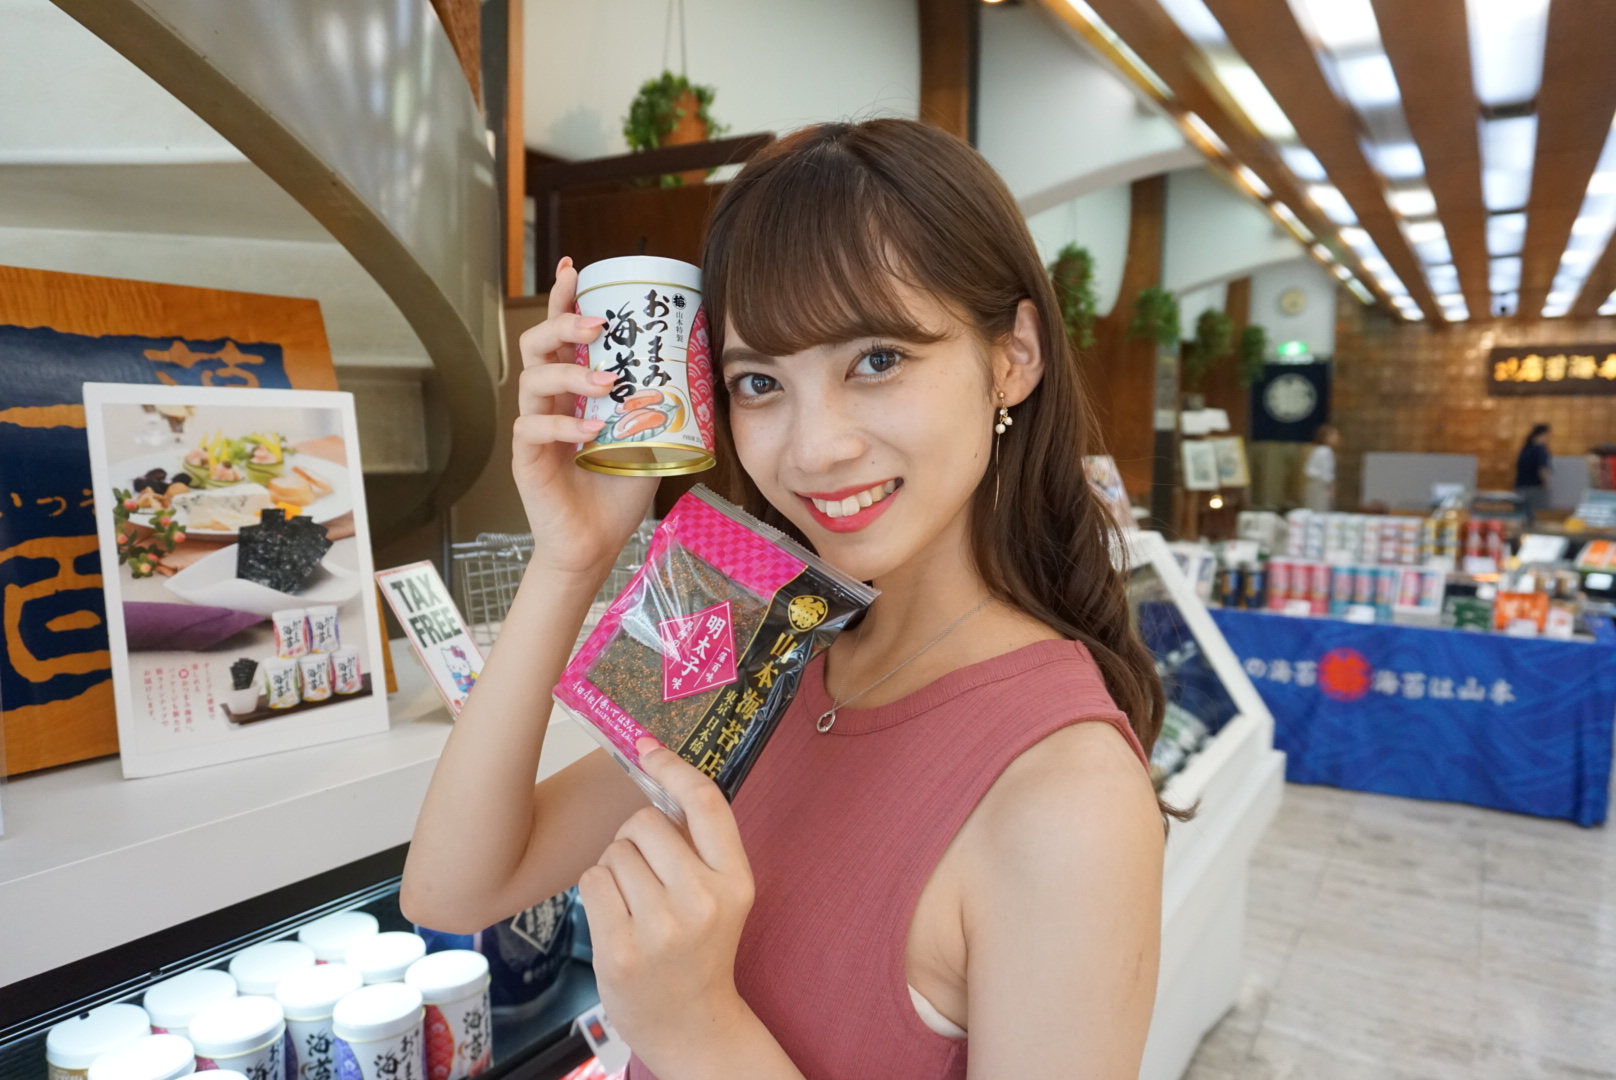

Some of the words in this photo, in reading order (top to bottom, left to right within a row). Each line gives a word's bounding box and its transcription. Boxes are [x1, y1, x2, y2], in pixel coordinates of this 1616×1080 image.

[601, 300, 646, 404] 海苔
[642, 288, 672, 388] おつまみ
[390, 573, 443, 613] TAX
[408, 606, 463, 648] FREE
[696, 632, 798, 781] 山本海苔店
[715, 690, 739, 717] 東京
[1373, 668, 1516, 706] 海苔は山本
[688, 716, 720, 756] 日本橋
